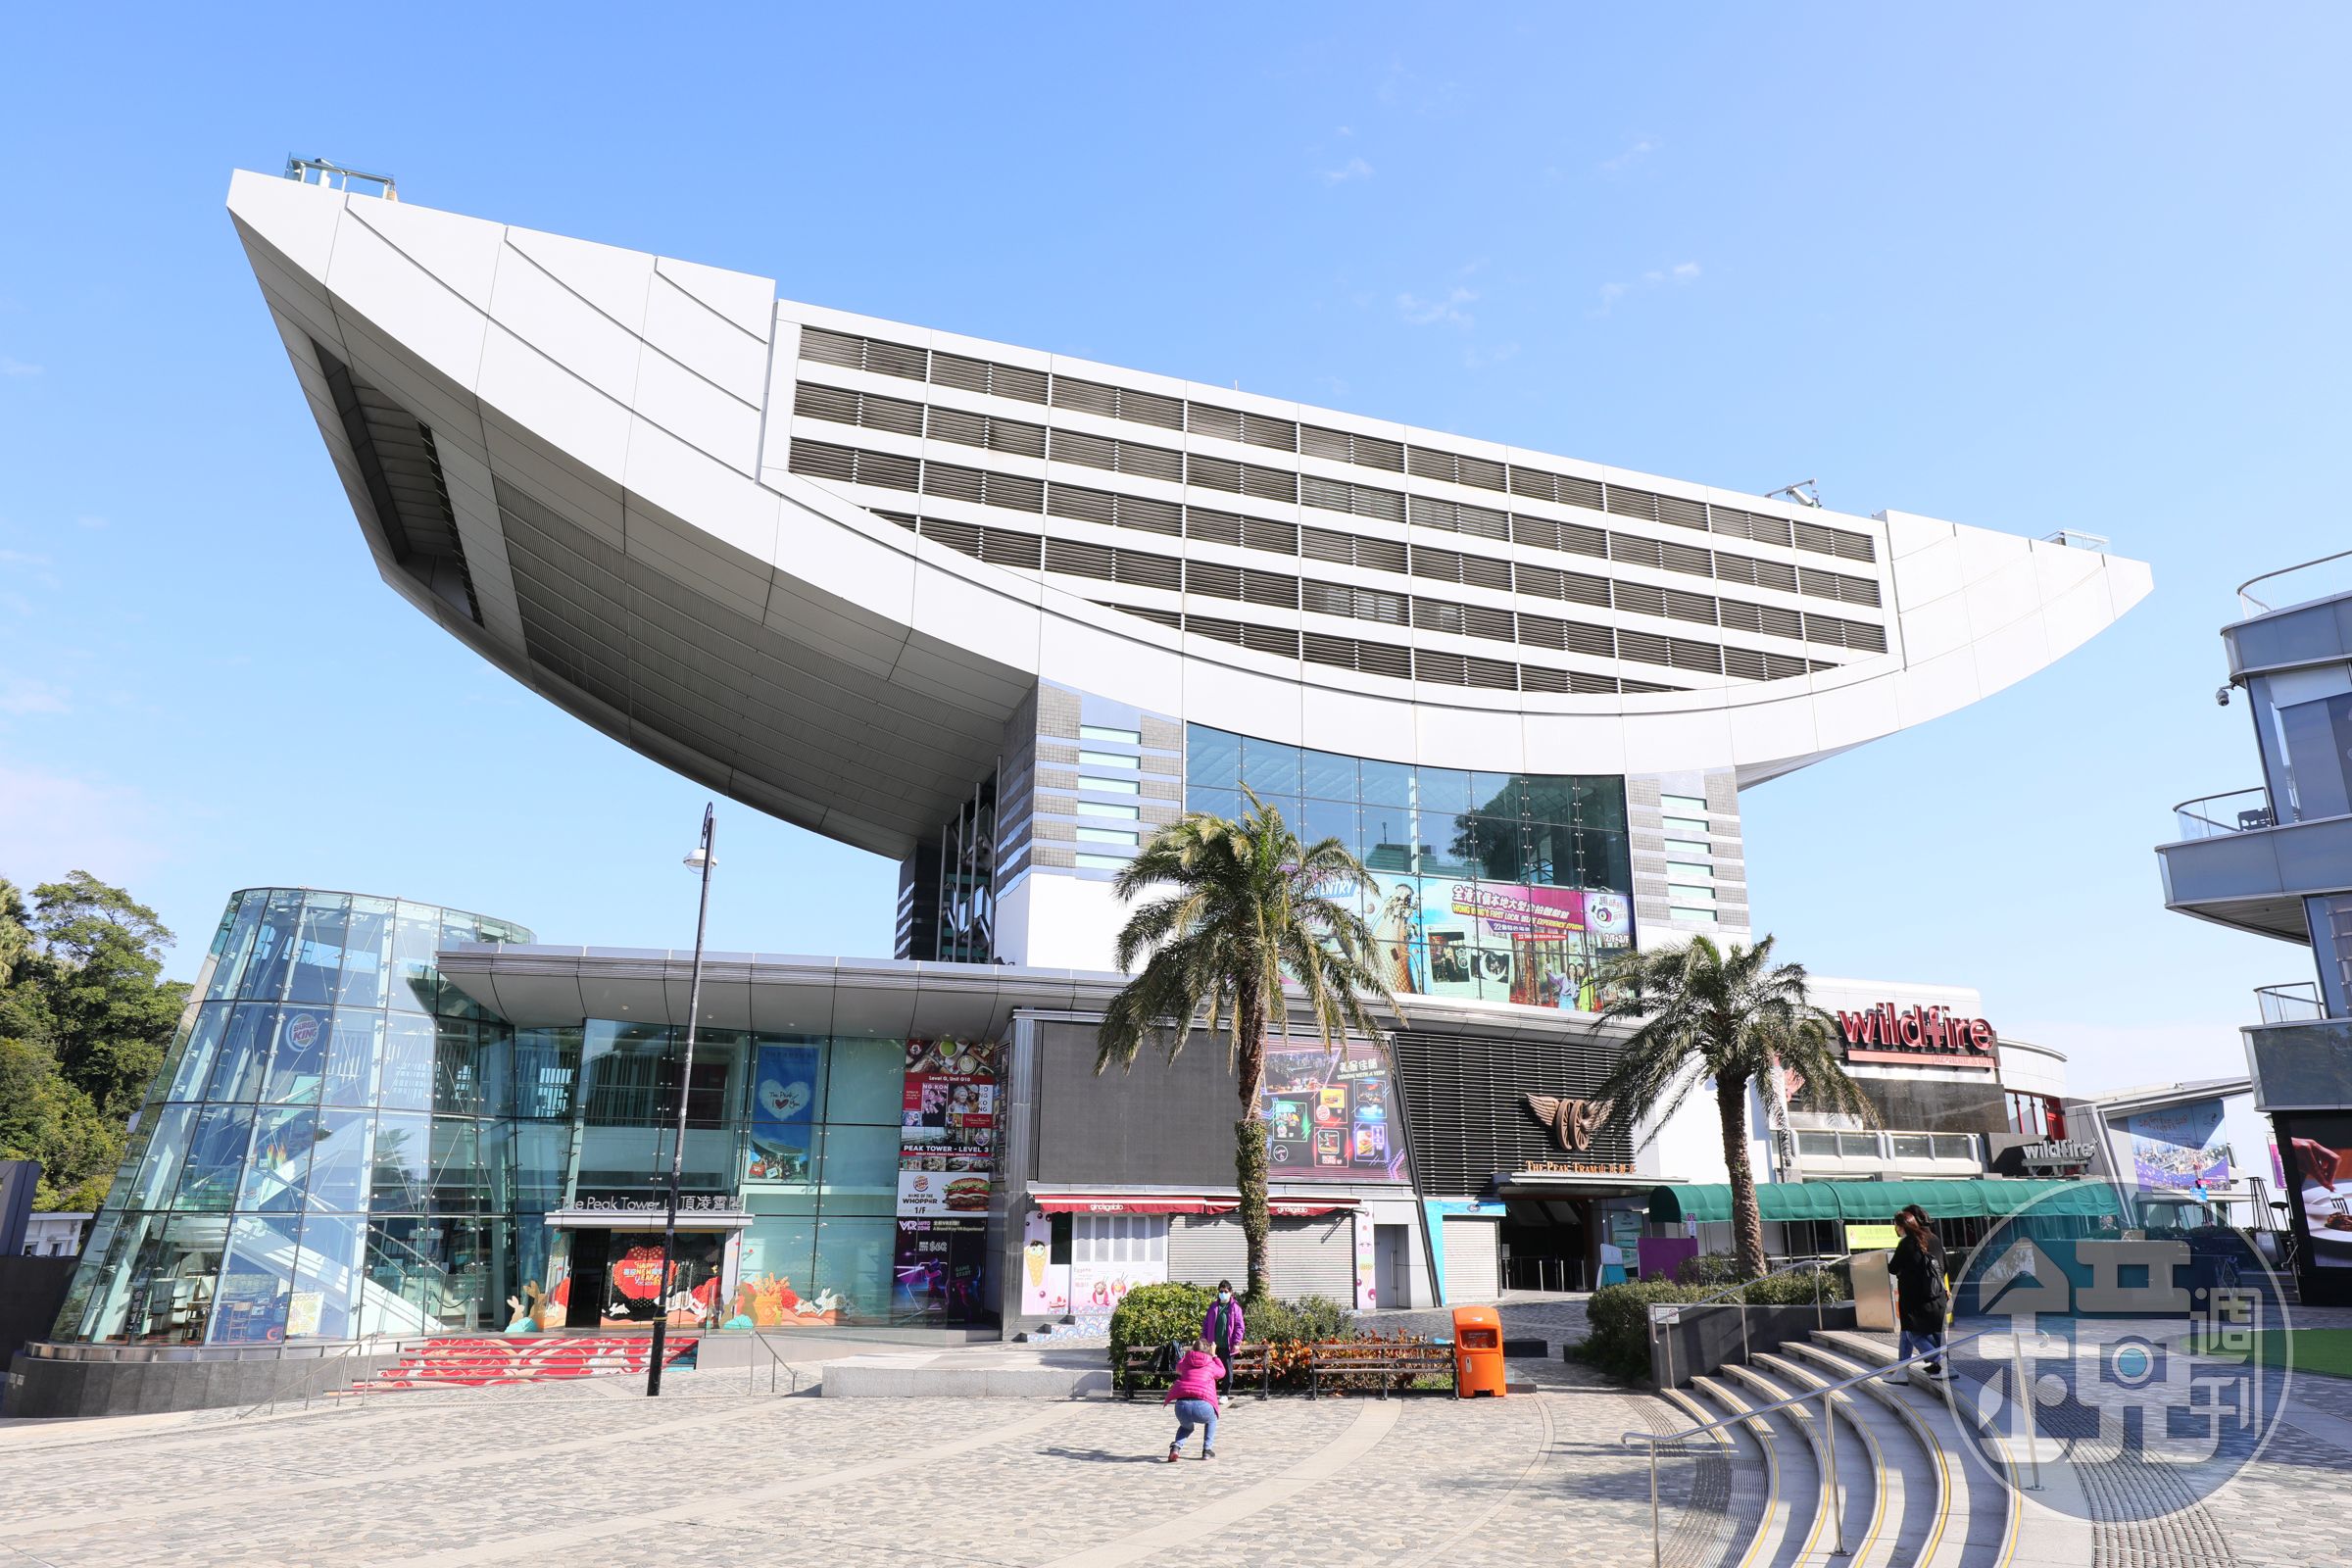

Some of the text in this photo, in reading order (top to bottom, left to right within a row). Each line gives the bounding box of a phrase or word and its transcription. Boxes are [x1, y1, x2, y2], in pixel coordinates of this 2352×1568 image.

[1837, 1002, 1994, 1051] wildfire
[2023, 1139, 2095, 1158] wildfire
[1546, 1160, 1569, 1173] PEAK
[1572, 1161, 1596, 1174] TRAM
[586, 1195, 617, 1211] Peak
[620, 1197, 661, 1211] Tower
